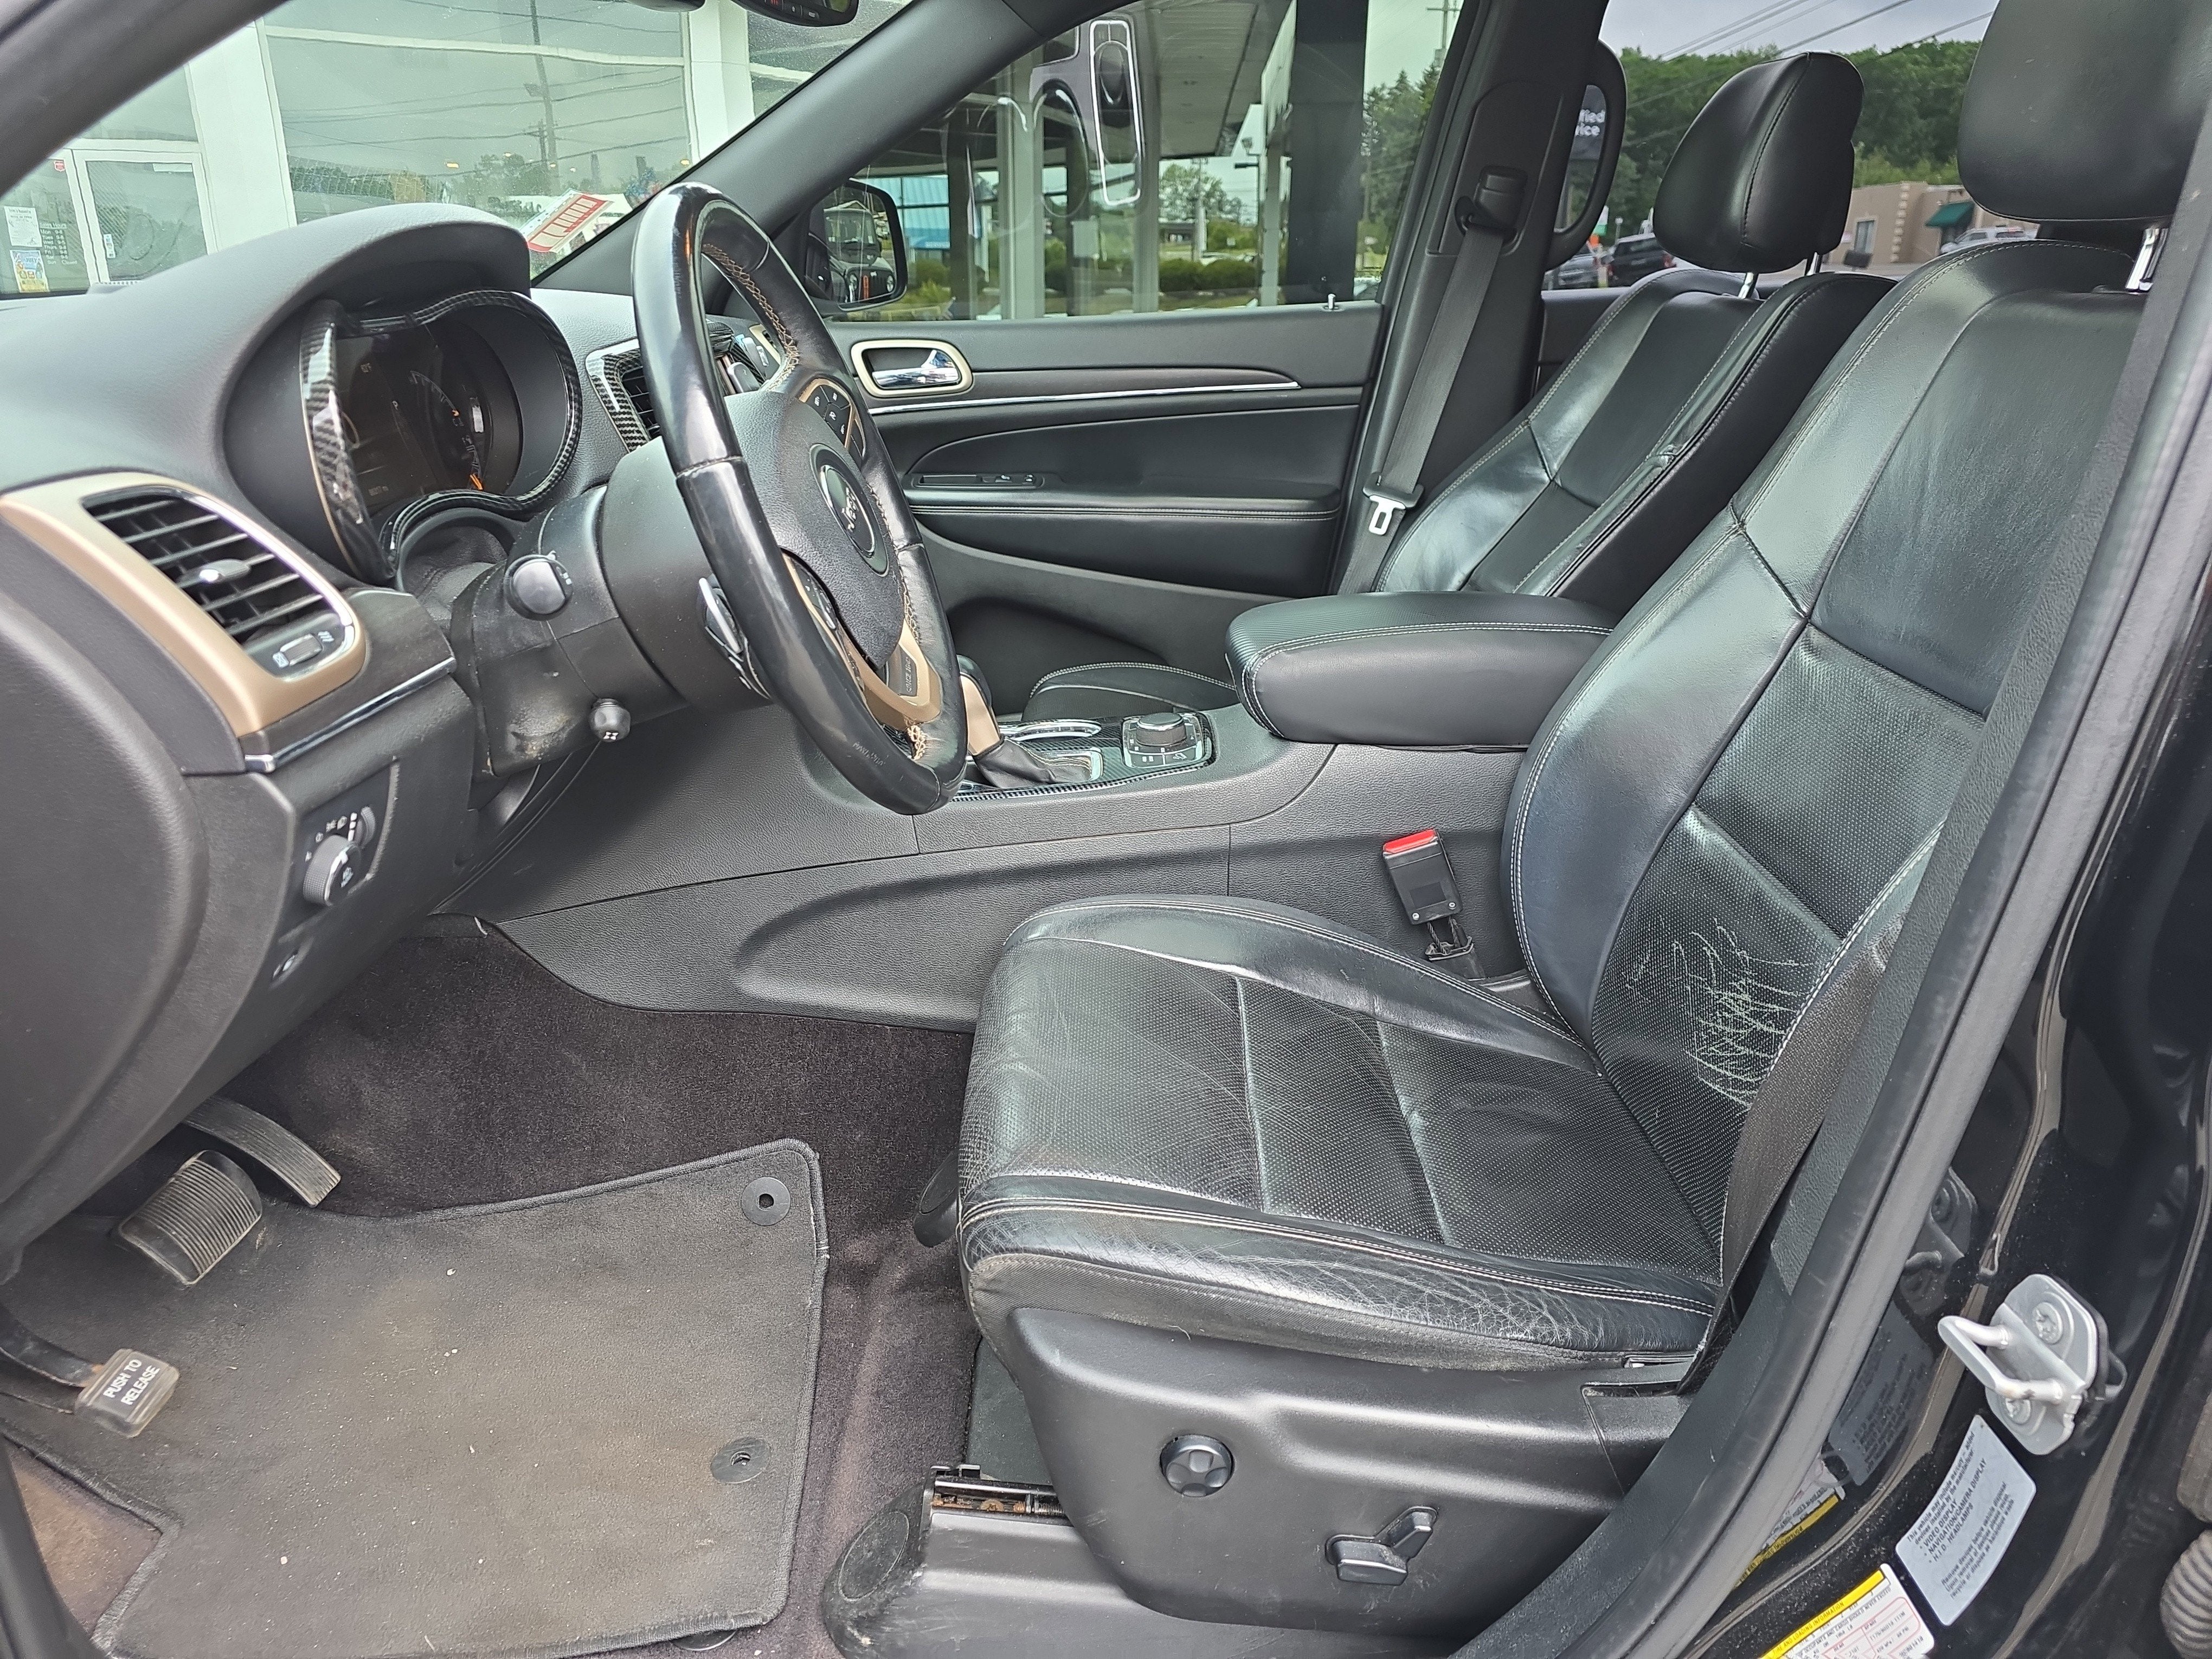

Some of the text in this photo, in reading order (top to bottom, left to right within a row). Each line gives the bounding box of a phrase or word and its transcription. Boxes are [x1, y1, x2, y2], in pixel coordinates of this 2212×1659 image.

[103, 1359, 142, 1399] PUSH TO
[120, 1365, 160, 1405] RELEASE
[1907, 1530, 1918, 1542] This
[1918, 1512, 1932, 1531] vehicle
[1939, 1481, 1952, 1501] include
[1915, 1525, 1931, 1545] devices
[1931, 1502, 1946, 1525] installed
[1924, 1499, 1957, 1546] VIDEO DISPLAY
[1928, 1458, 1986, 1554] NAVIGATION/CAMERA DISPLAY
[1947, 1502, 1973, 1543] HEADLAMPS
[1783, 1638, 1792, 1648] AND
[1792, 1623, 1812, 1641] LOADING
[1812, 1600, 1844, 1626] INFORMATION
